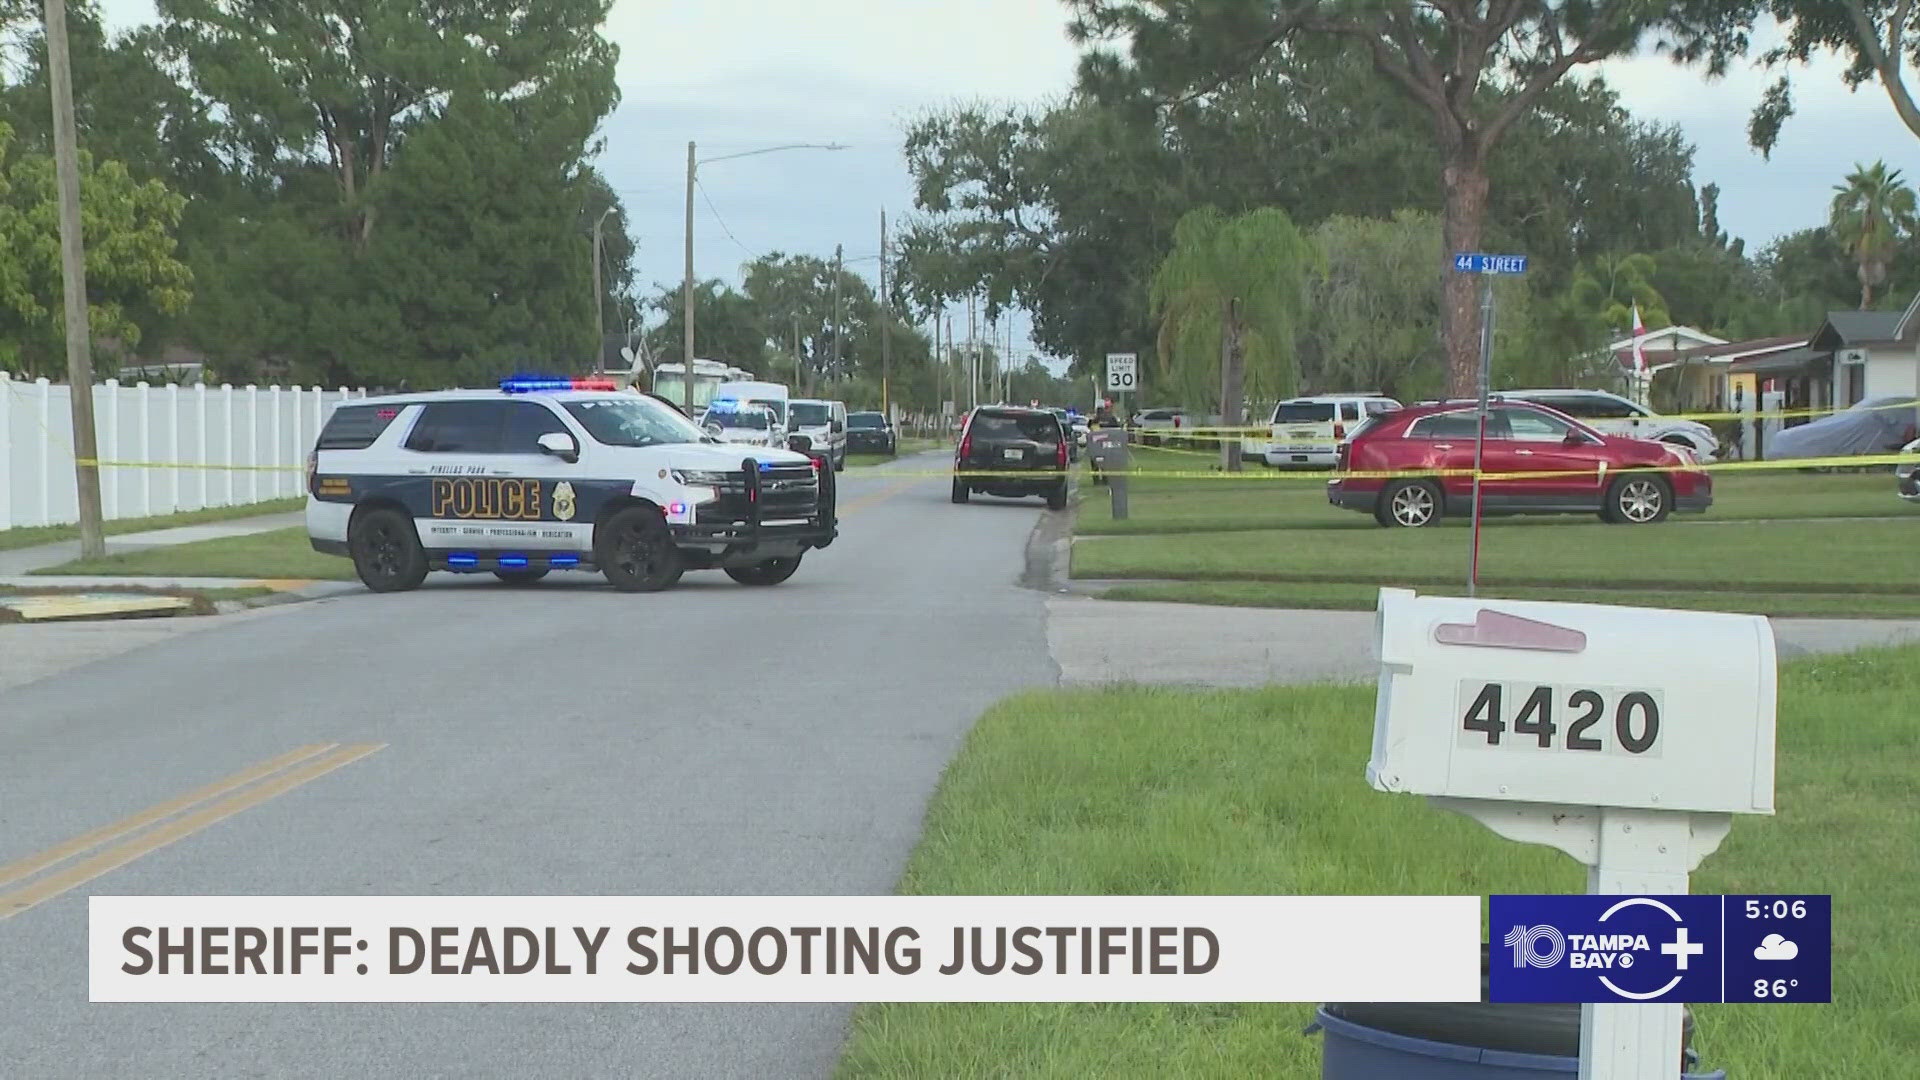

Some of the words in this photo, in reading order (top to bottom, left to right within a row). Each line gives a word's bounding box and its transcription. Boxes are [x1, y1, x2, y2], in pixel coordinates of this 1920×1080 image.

[1457, 256, 1472, 270] 44
[1481, 257, 1525, 272] STREET
[1111, 373, 1133, 386] 30
[432, 478, 541, 518] POLICE
[1464, 683, 1659, 753] 4420
